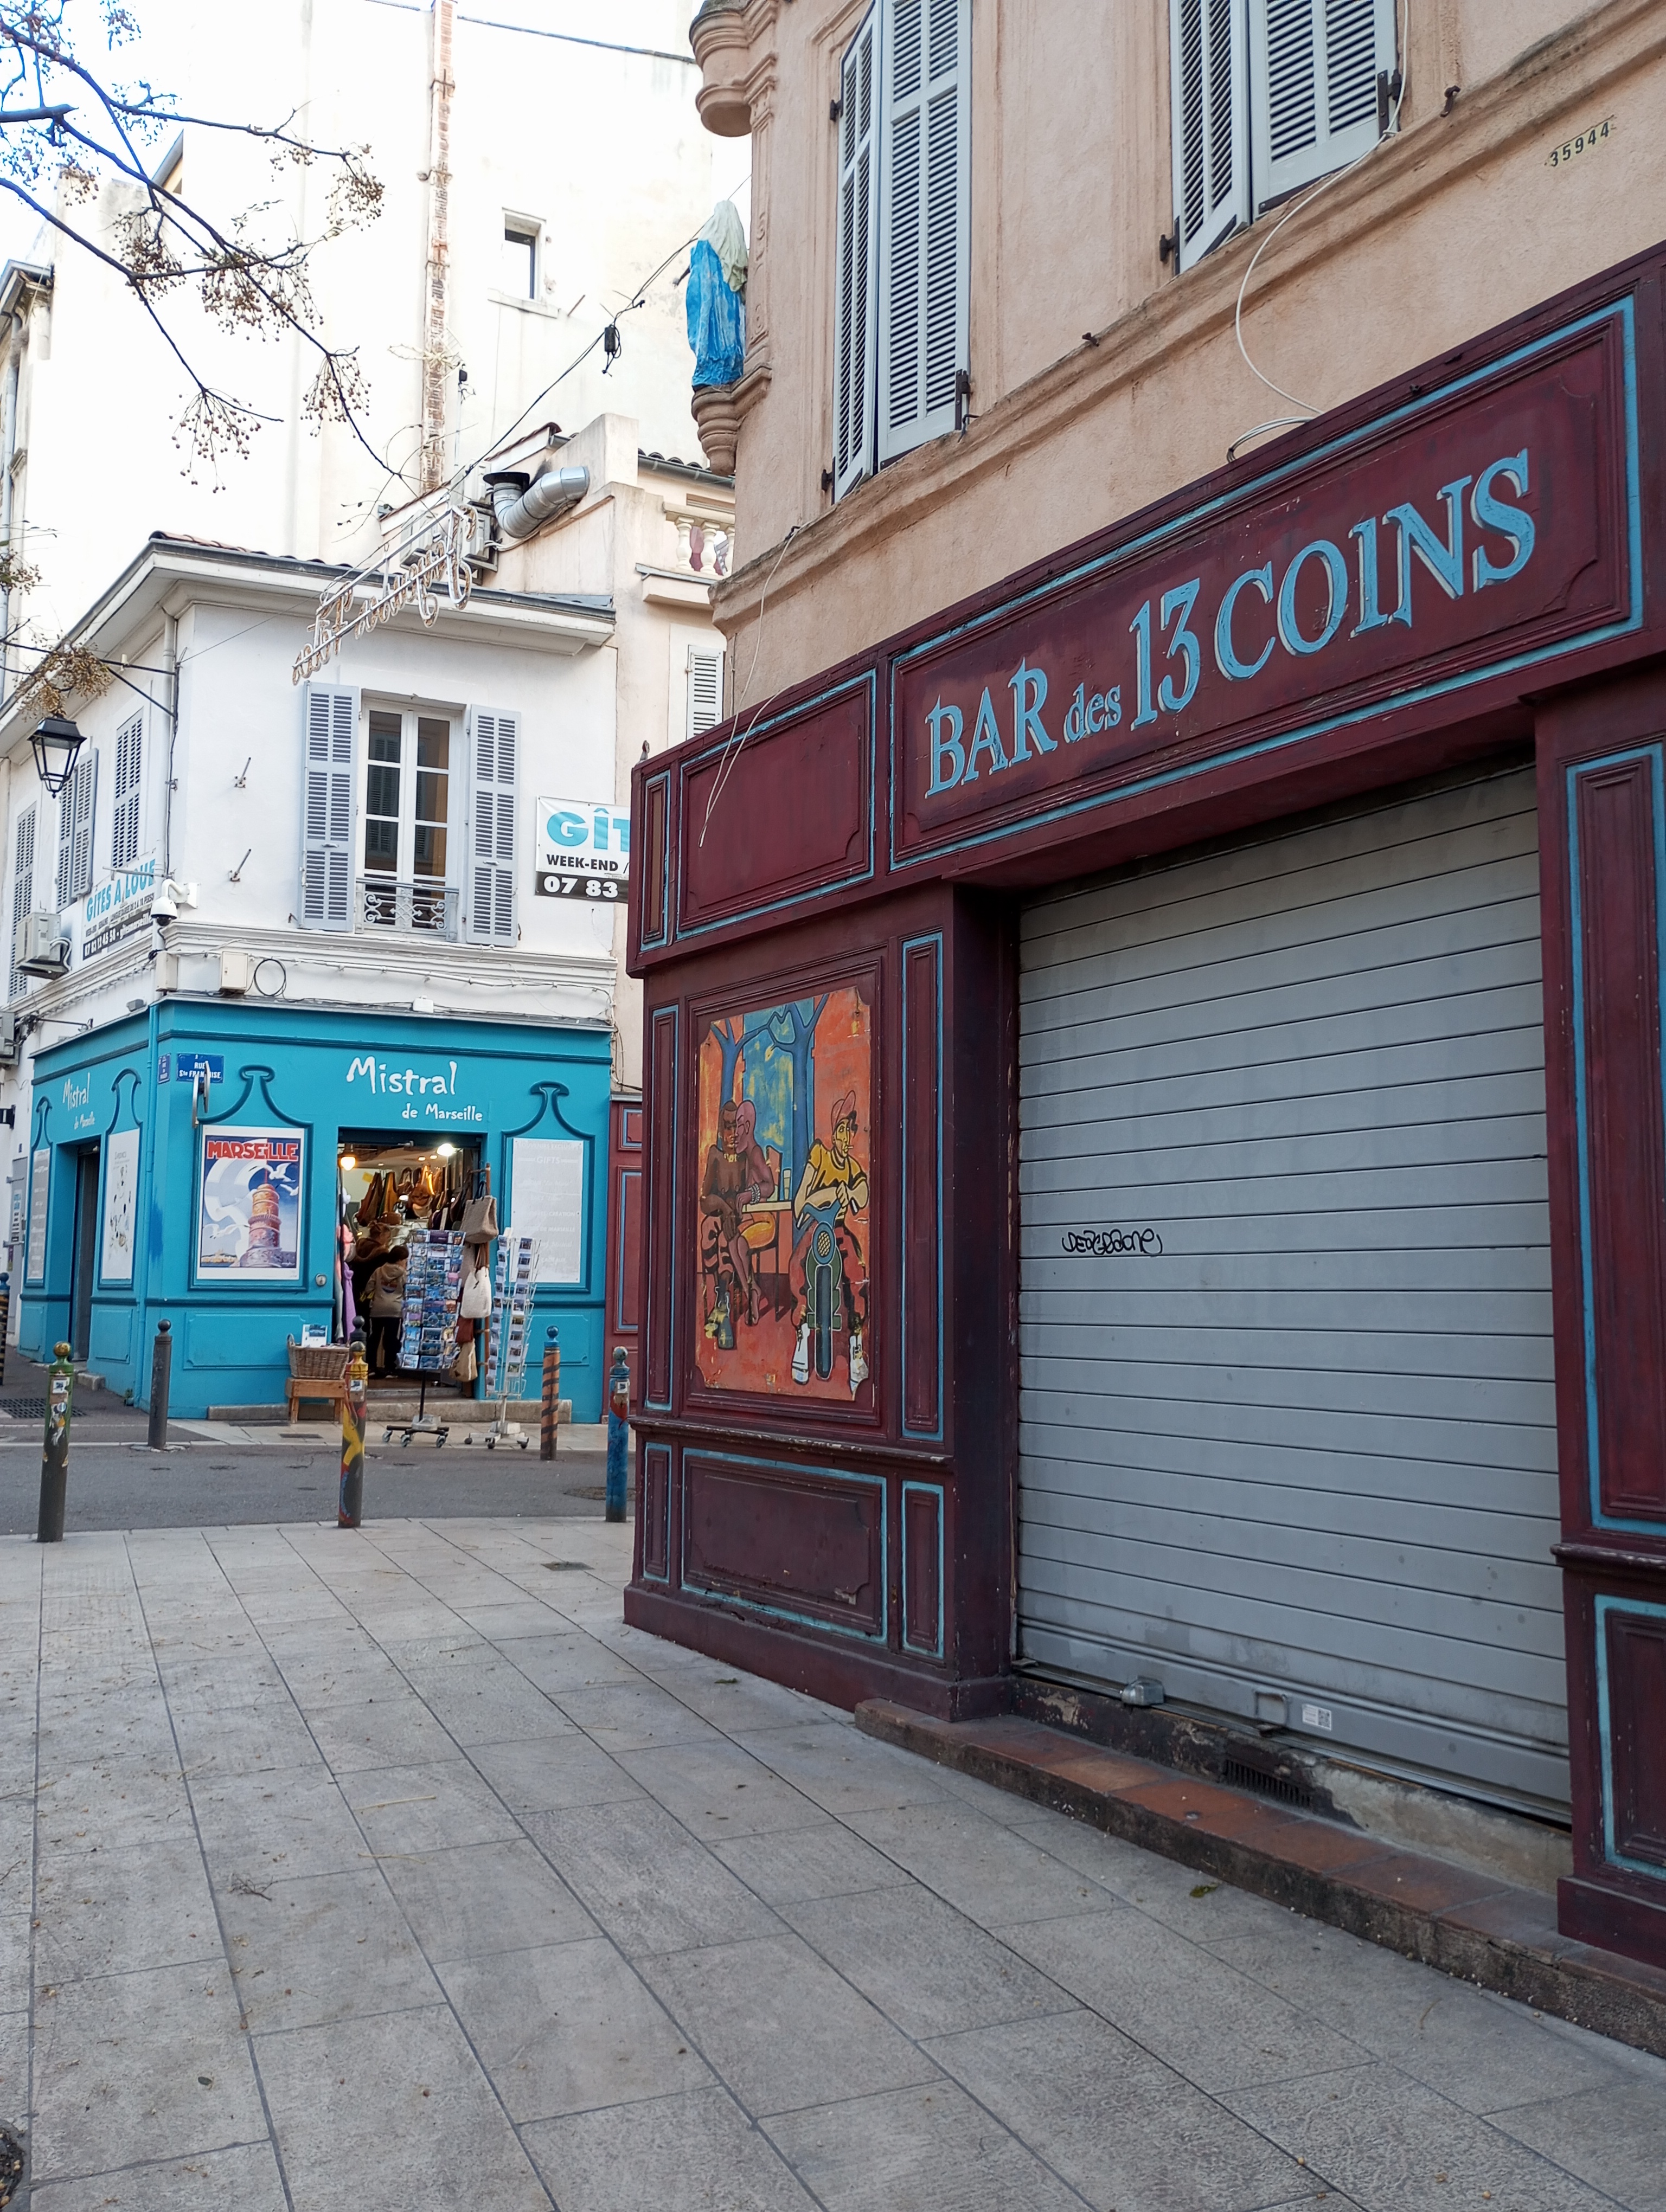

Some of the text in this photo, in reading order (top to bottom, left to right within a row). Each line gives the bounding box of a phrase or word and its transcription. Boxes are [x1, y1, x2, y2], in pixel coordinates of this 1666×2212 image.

[1549, 121, 1609, 167] 35944
[924, 448, 1537, 799] BAR des 13 COINS
[546, 853, 618, 872] WEEK-END
[113, 878, 121, 906] A
[543, 875, 618, 898] 07 83
[346, 1056, 458, 1096] Mistral
[62, 1072, 91, 1111] Mistral
[401, 1103, 483, 1122] de Marseille
[207, 1140, 299, 1161] MARSEILLE
[536, 1156, 561, 1164] GIFTS
